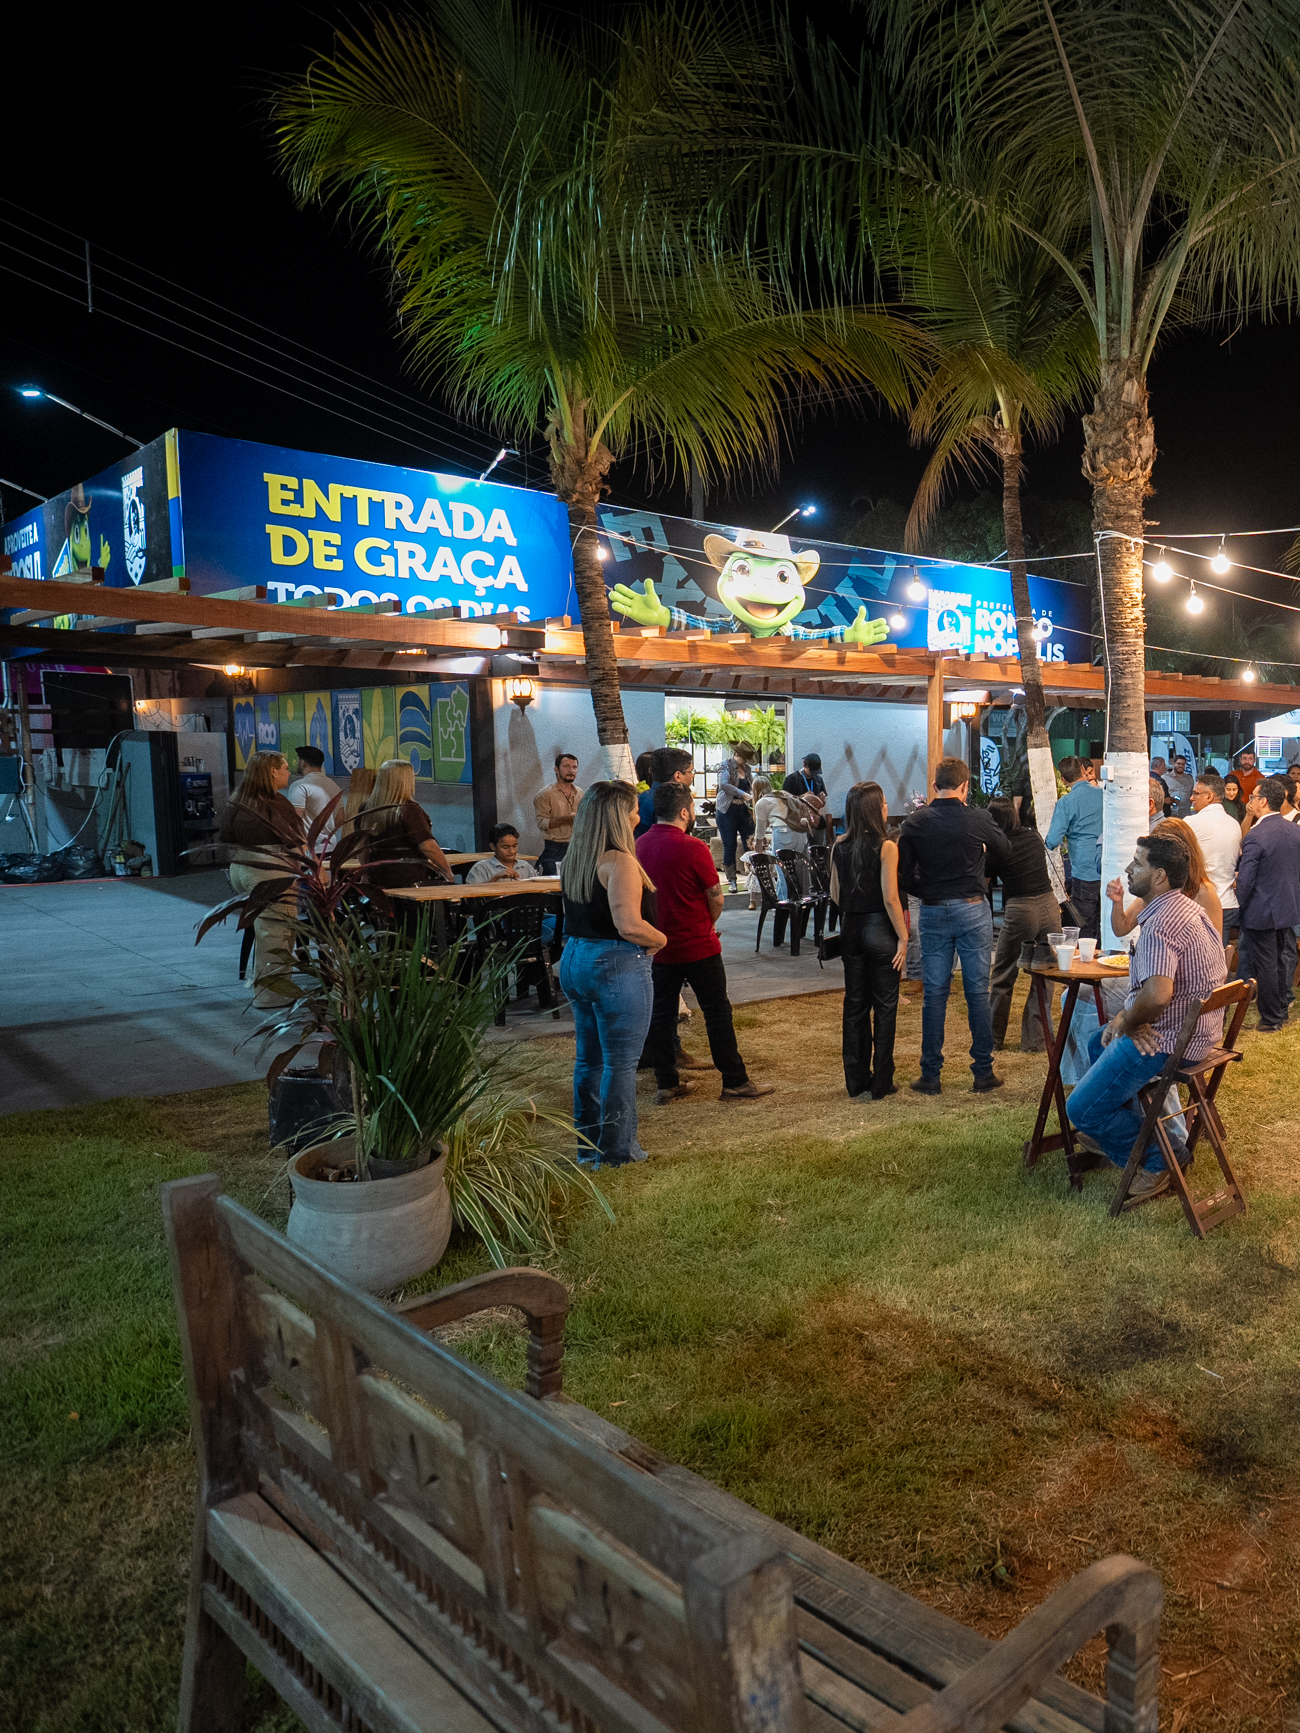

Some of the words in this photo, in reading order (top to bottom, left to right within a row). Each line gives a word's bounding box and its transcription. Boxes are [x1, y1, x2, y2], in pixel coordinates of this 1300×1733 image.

[263, 472, 517, 547] ENTRADA
[33, 521, 39, 543] A
[265, 524, 344, 571] DE
[354, 537, 528, 596] GRAÇA
[975, 608, 1054, 640] RONO
[1042, 609, 1053, 617] DE
